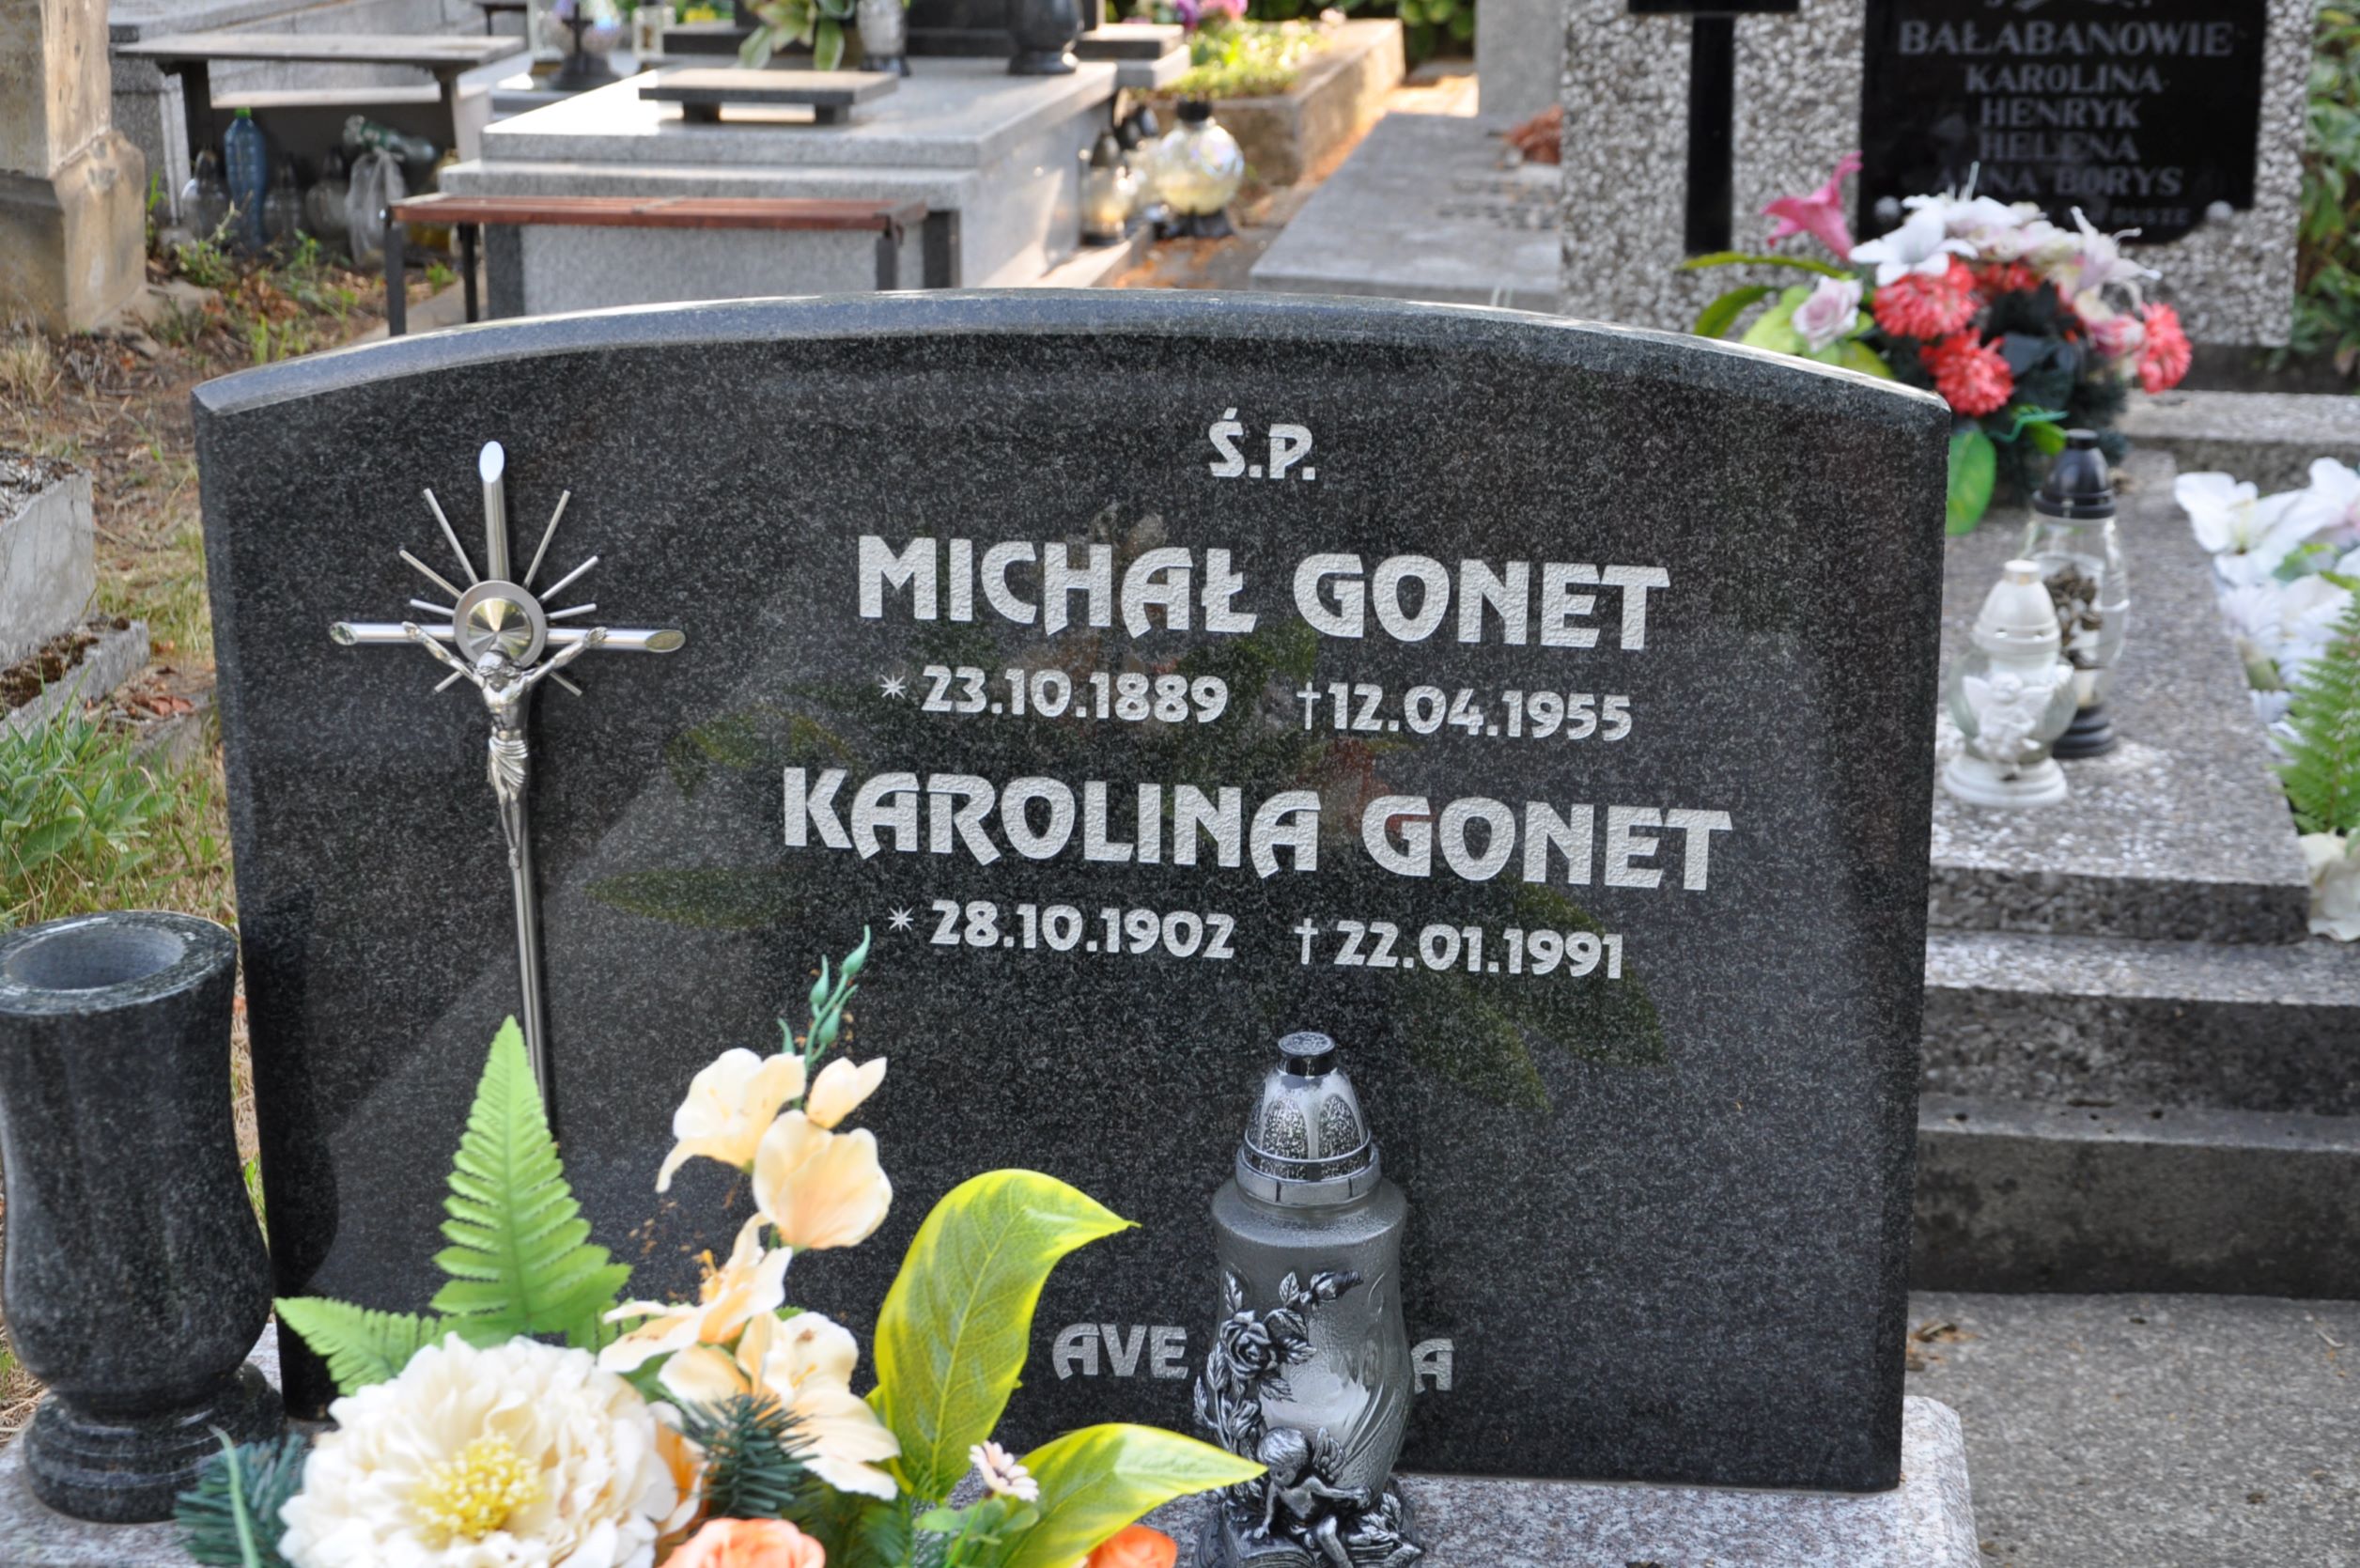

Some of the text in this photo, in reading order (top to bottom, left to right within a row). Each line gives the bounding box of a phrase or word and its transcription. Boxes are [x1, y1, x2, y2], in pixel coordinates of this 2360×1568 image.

[1899, 21, 2234, 55] BAŁABANOWIE
[1965, 63, 2164, 93] KAROLINA
[1980, 98, 2142, 129] HENRYK
[1979, 132, 2141, 162] HELENA
[2054, 165, 2184, 197] BORYS
[1209, 408, 1315, 480] Ś.P.
[859, 536, 1670, 650] MICHAŁ GONET
[922, 665, 1632, 741] 23.10.1889 12.04.1955
[784, 767, 1732, 891] KAROLINA GONET
[930, 900, 1622, 979] 28.10.1902 22.01.1991
[1052, 1323, 1188, 1380] AVE
